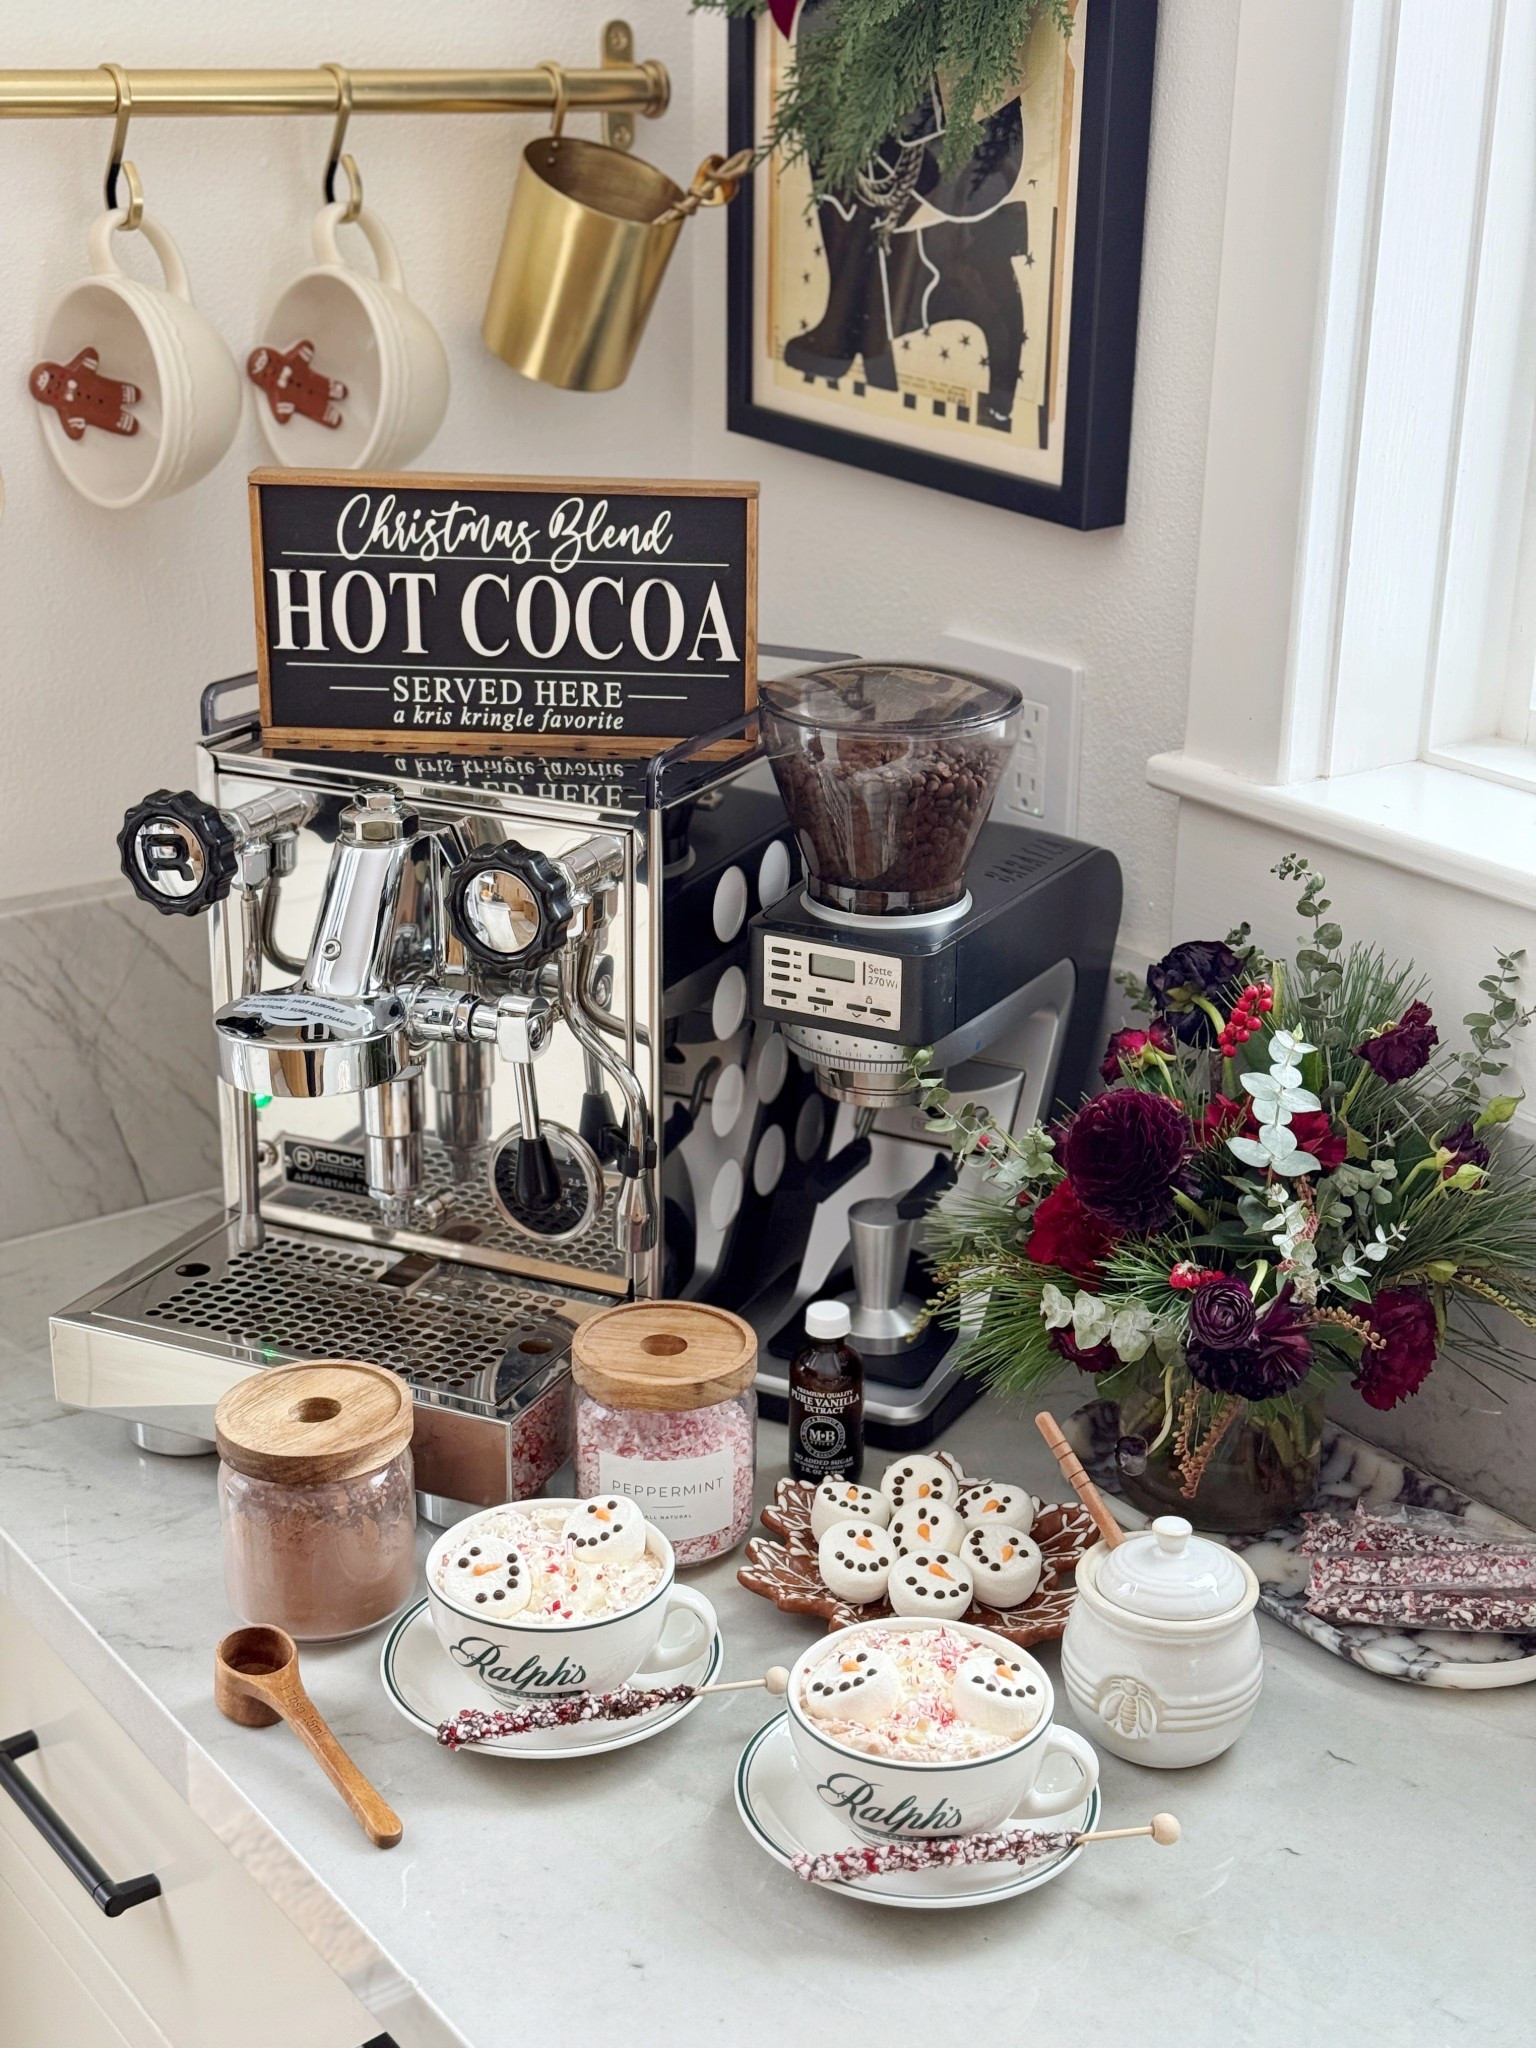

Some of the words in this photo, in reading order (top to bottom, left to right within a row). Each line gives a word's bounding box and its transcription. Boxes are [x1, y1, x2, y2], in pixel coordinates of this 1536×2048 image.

[337, 493, 541, 564] Christmas
[548, 497, 674, 573] Blend
[269, 568, 437, 654] HOT
[460, 573, 741, 663] COCOA
[393, 675, 523, 705] SERVED
[534, 680, 624, 709] HERE
[393, 708, 406, 724] a
[412, 705, 453, 725] kris
[460, 707, 535, 732] kringle
[537, 708, 625, 733] favorite
[141, 833, 195, 882] R
[868, 963, 893, 977] Sette
[242, 1003, 285, 1011] ATTENTION
[289, 1006, 326, 1018] SURFACE
[323, 1013, 357, 1028] CHAUDE
[310, 1001, 346, 1014] SURFACE
[315, 1151, 363, 1168] ROCK
[315, 1166, 354, 1178] ESPRESSO
[294, 1173, 369, 1193] APPARTAMEN
[568, 1177, 581, 1187] 2.5
[566, 1200, 572, 1208] 3
[792, 1388, 813, 1405] PURE
[814, 1393, 859, 1407] VANILLA
[797, 1386, 825, 1398] PREMIUM
[826, 1389, 854, 1399] QUALITY
[805, 1405, 844, 1414] EXTRACT
[803, 1456, 830, 1466] ADDED
[830, 1455, 854, 1466] SUGAR
[612, 1476, 724, 1498] PEPPERMINT
[449, 1636, 587, 1691] Ralph's
[505, 1688, 569, 1698] COFFEE
[286, 1689, 306, 1714] Tbsp
[303, 1714, 328, 1739] 15ml
[816, 1772, 963, 1833] Ralph's
